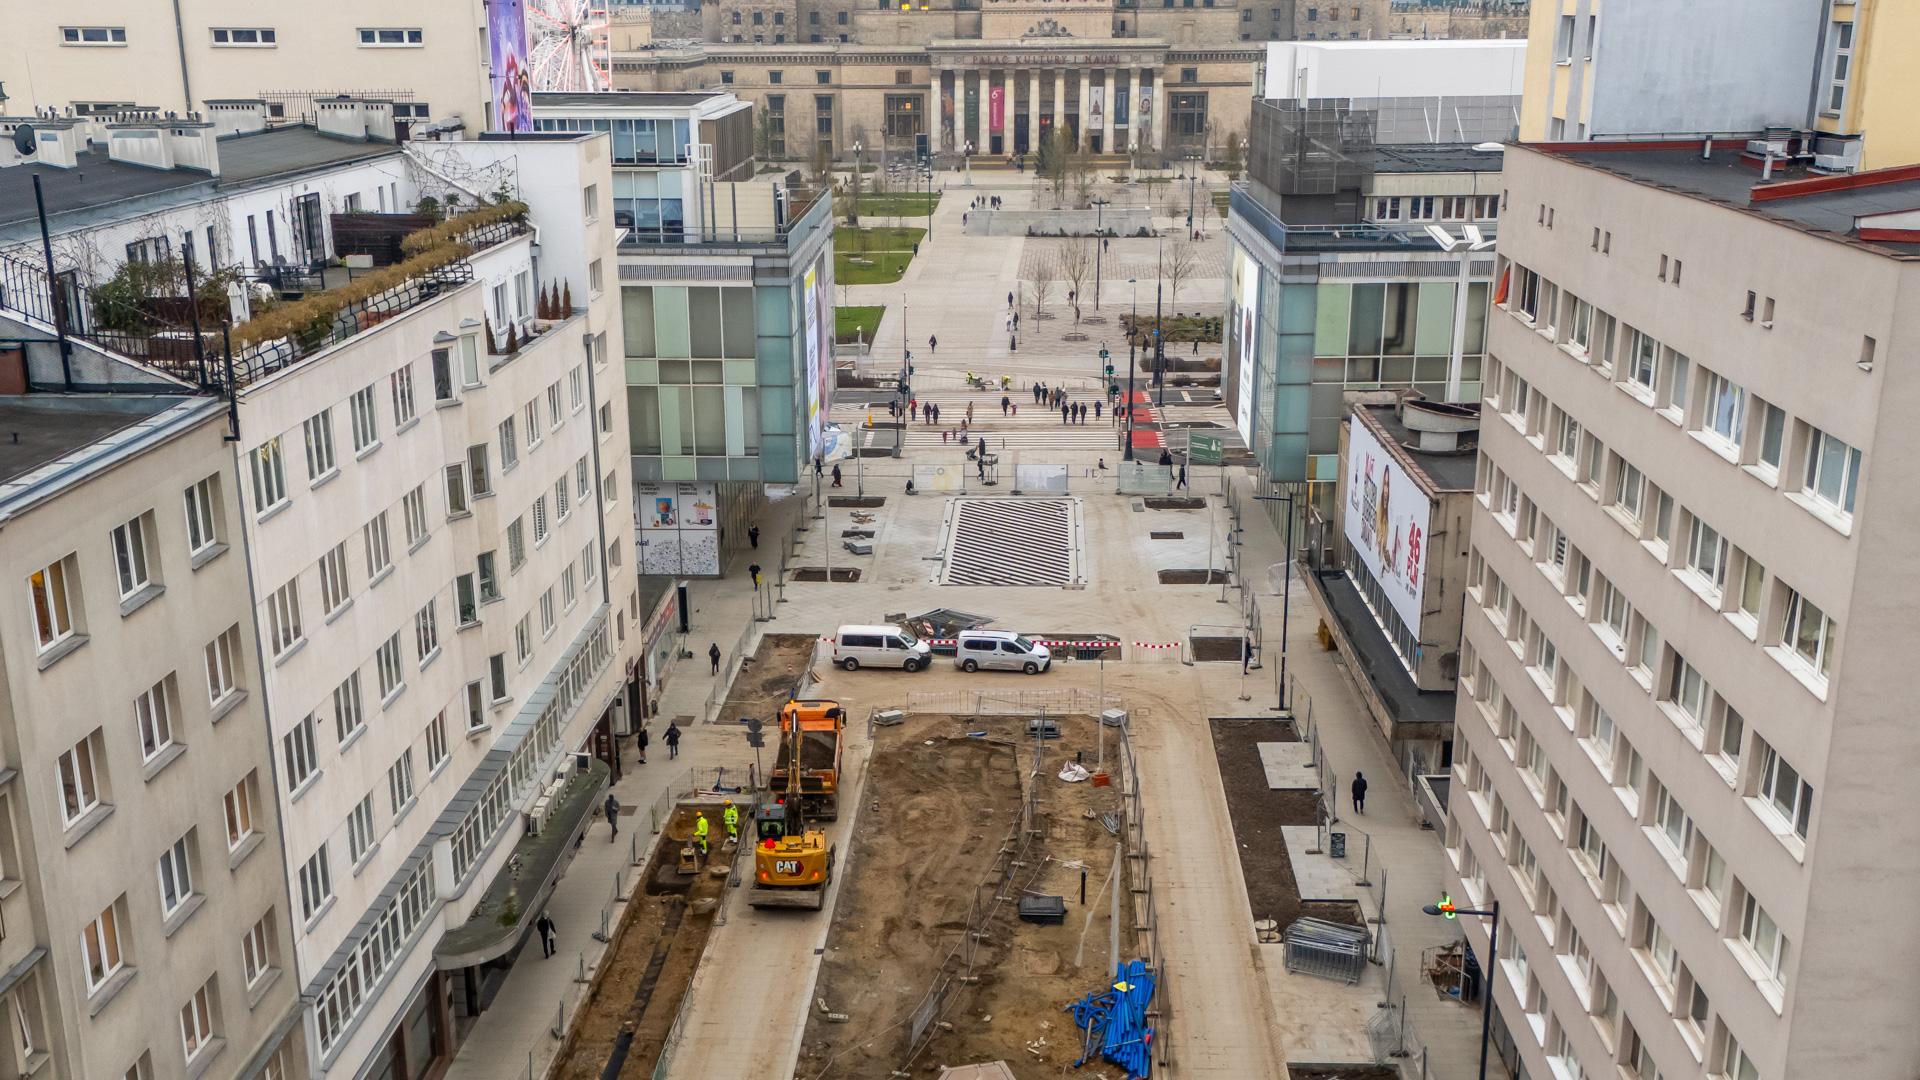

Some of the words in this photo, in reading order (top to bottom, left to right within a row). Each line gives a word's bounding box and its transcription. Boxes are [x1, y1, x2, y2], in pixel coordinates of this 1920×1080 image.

[1016, 55, 1067, 64] KULTURY
[1085, 55, 1120, 64] NAUKI
[1408, 522, 1421, 565] 46
[1406, 555, 1418, 589] PLN
[776, 860, 798, 873] CAT
